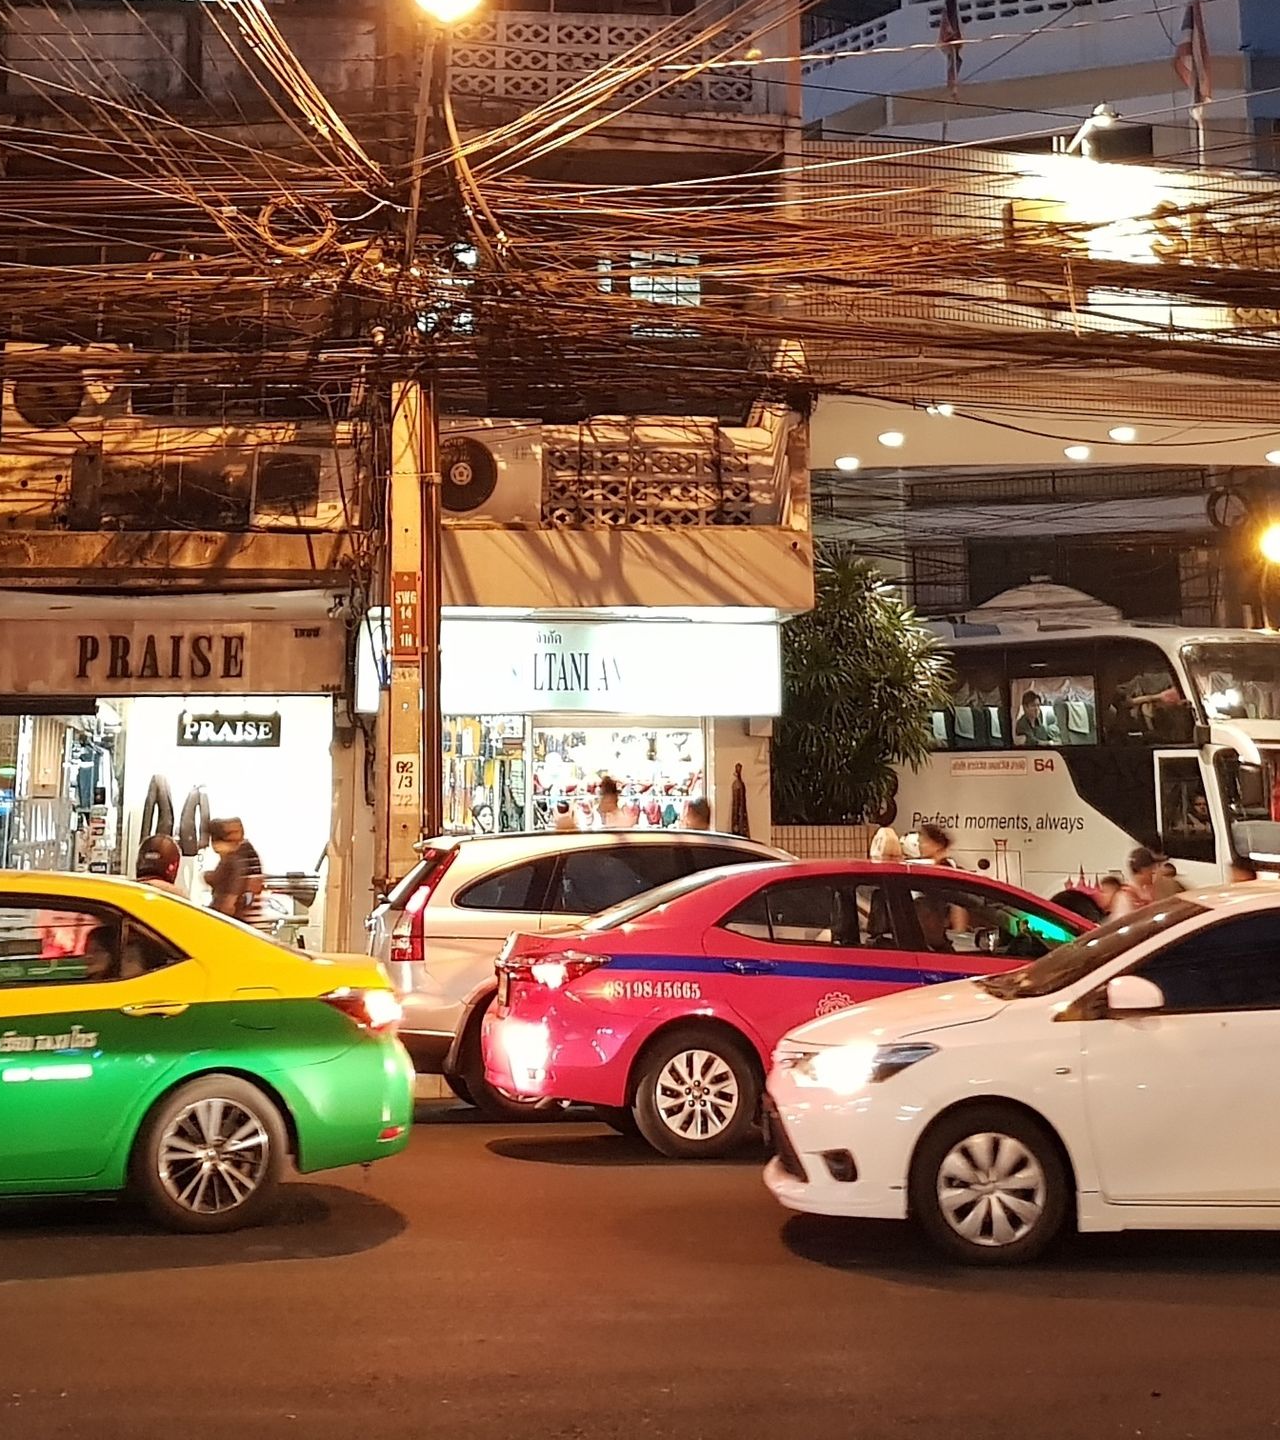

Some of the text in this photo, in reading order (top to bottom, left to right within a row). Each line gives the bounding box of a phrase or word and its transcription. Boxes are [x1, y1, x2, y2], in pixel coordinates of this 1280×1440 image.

[399, 606, 413, 620] 14
[76, 634, 246, 679] PRAISE
[183, 720, 273, 743] PRAISE
[1033, 758, 1055, 773] 64
[912, 811, 1085, 834] Perfect moments, always
